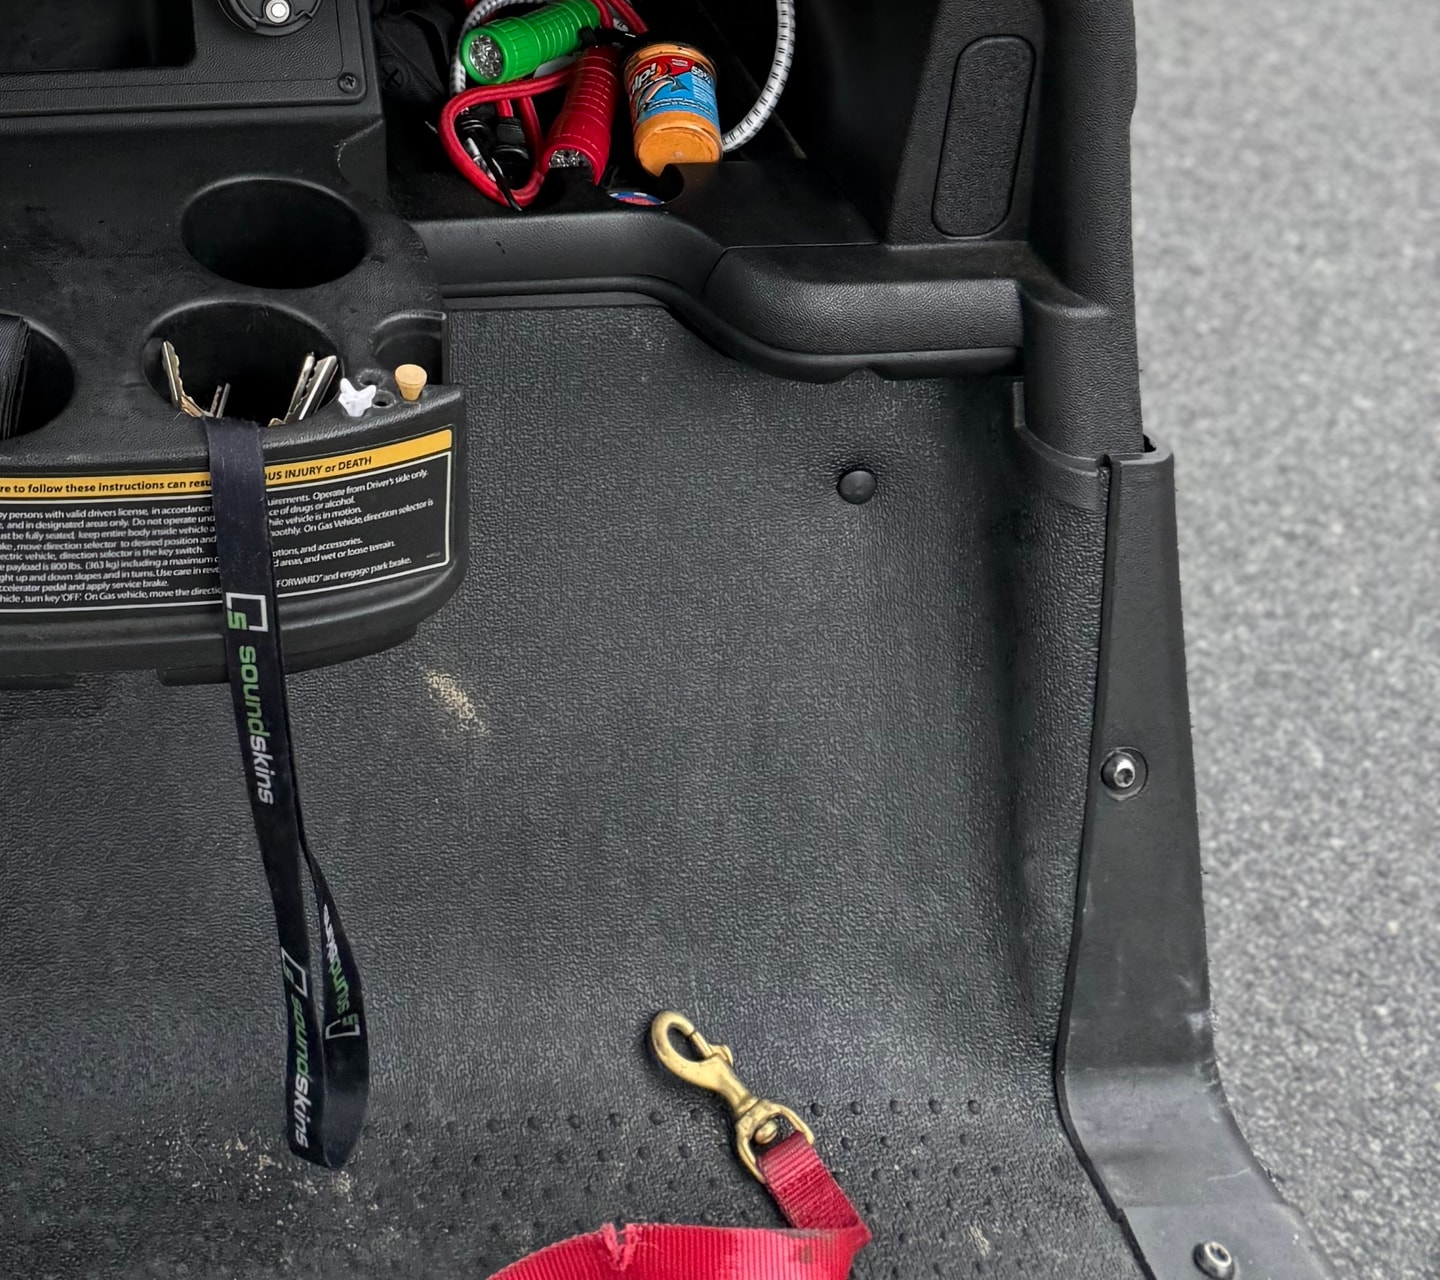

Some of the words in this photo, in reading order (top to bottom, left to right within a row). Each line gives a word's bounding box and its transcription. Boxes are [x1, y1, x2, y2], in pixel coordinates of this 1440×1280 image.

[13, 485, 25, 493] to
[28, 484, 61, 493] follow
[66, 484, 96, 493] these
[99, 481, 164, 492] instructions
[168, 481, 186, 489] can
[189, 480, 212, 488] resu
[285, 466, 322, 479] INJURY
[325, 465, 336, 473] or
[338, 456, 372, 470] DEATH
[9, 512, 43, 520] persons
[45, 510, 64, 518] with
[66, 510, 85, 518] valid
[88, 509, 116, 518] drivers
[162, 505, 210, 515] accordance
[313, 489, 345, 502] Operate
[346, 485, 365, 494] from
[396, 474, 410, 484] side
[7, 520, 24, 529] and
[36, 520, 84, 530] designated
[132, 518, 145, 526] Do
[147, 518, 162, 526] not
[164, 516, 196, 526] operate
[290, 504, 314, 514] drugs
[26, 531, 43, 541] fully
[128, 528, 150, 538] body
[152, 526, 177, 536] inside
[179, 524, 208, 534] vehicle
[286, 515, 314, 525] vehicle
[44, 541, 82, 550] direction
[84, 541, 116, 549] selector
[121, 540, 129, 548] to
[164, 536, 198, 548] position
[200, 534, 216, 543] and
[304, 524, 317, 533] On
[318, 523, 333, 531] Gas
[364, 510, 397, 523] direction
[399, 502, 427, 515] selector
[7, 562, 41, 572] payload
[121, 559, 160, 568] including
[169, 556, 213, 566] maximum
[29, 573, 46, 581] and
[48, 573, 73, 581] down
[75, 572, 102, 582] slopes
[103, 571, 120, 579] and
[156, 569, 172, 577] Use
[173, 568, 192, 576] care
[321, 552, 336, 561] wet
[60, 551, 98, 560] direction
[100, 550, 132, 559] selector
[143, 548, 157, 557] the
[159, 548, 173, 557] key
[42, 583, 66, 594] pedal
[68, 583, 84, 591] and
[86, 582, 110, 592] apply
[112, 580, 141, 590] service
[45, 594, 59, 604] key
[85, 593, 98, 601] On
[100, 592, 115, 600] Gas
[150, 590, 174, 598] move
[175, 588, 189, 596] the
[340, 567, 370, 578] engage
[371, 562, 387, 574] park
[239, 645, 276, 805] soundskins
